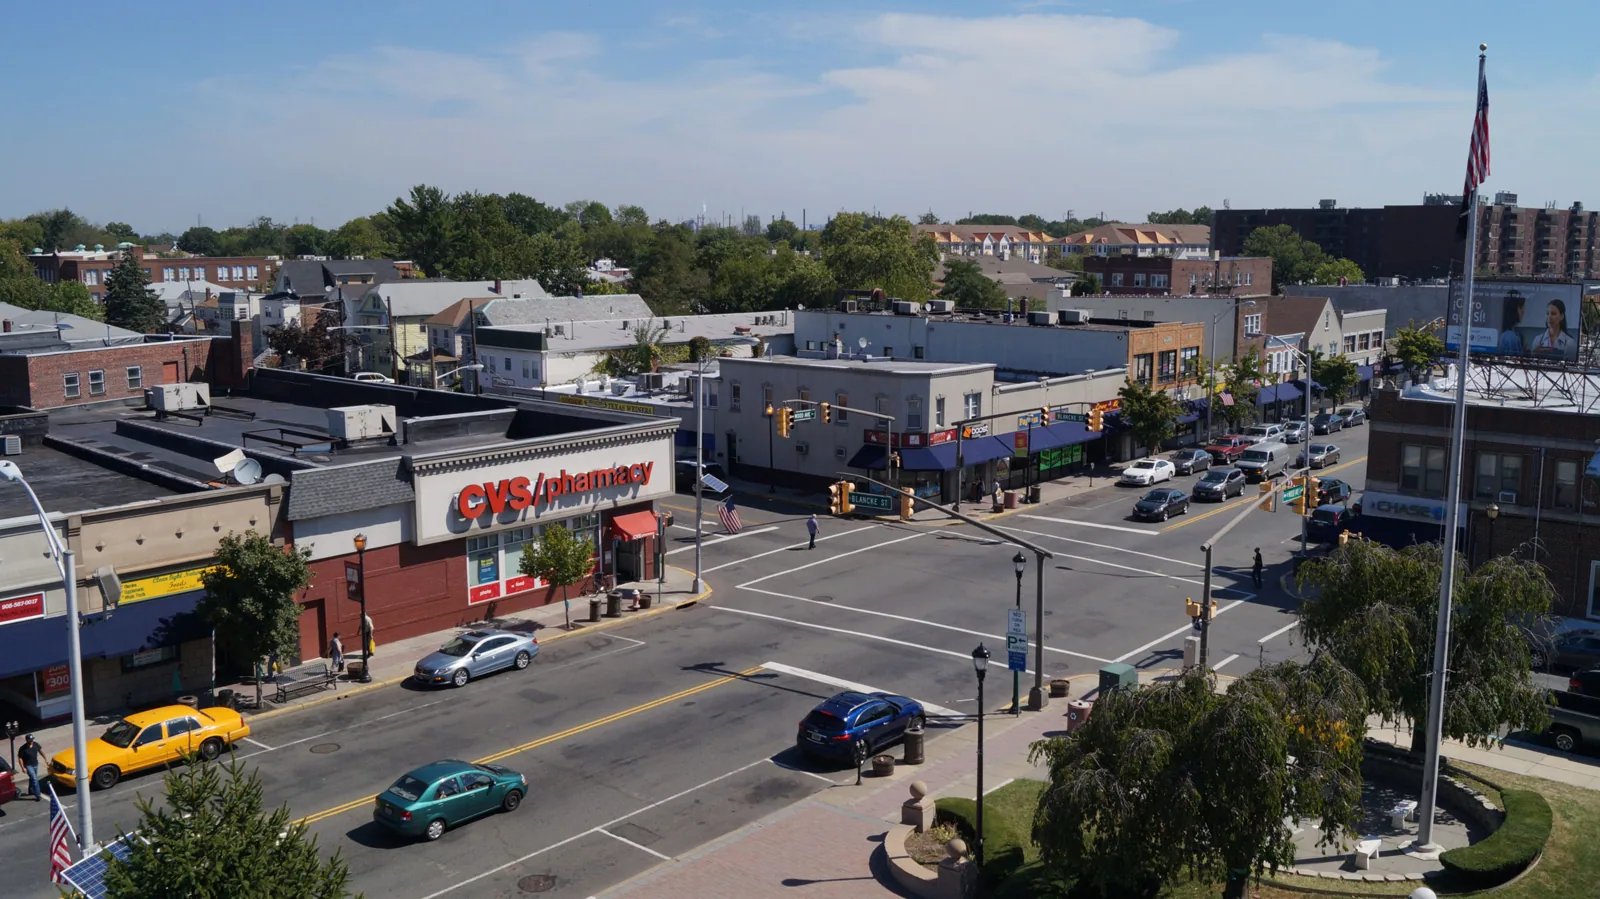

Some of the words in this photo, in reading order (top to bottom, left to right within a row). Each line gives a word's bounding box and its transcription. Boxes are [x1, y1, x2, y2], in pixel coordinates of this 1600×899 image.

[971, 424, 989, 435] boost
[851, 494, 879, 506] BLANCKE
[880, 498, 888, 507] ST
